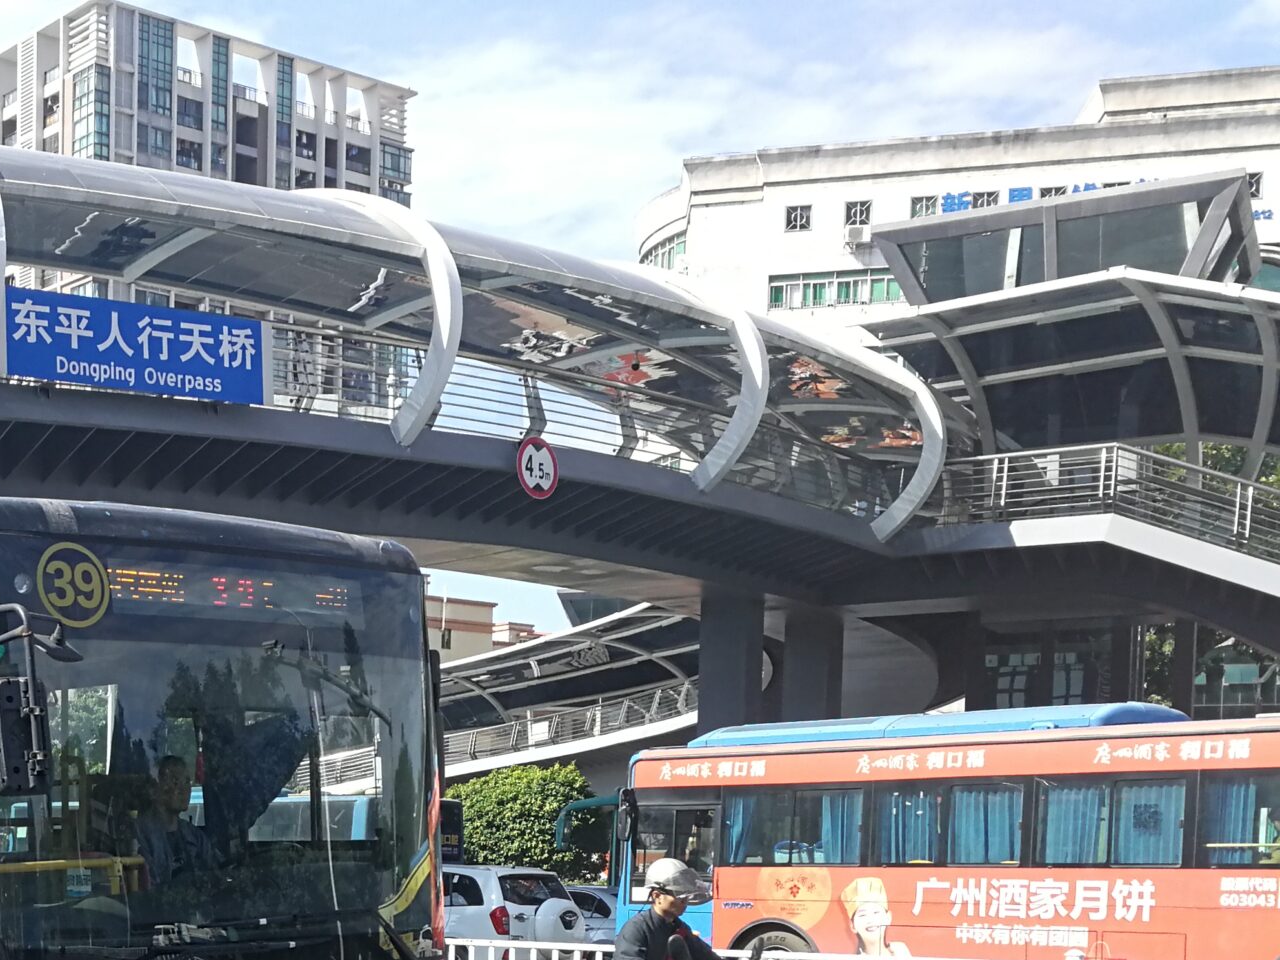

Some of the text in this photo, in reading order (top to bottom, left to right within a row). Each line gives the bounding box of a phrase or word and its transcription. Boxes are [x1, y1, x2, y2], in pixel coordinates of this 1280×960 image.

[11, 299, 256, 370] 东平人行天桥
[56, 356, 222, 393] Dongping Overpass
[524, 454, 551, 481] 4.5m
[45, 559, 101, 609] 39
[911, 877, 1157, 922] 广州酒家月饼
[1219, 893, 1276, 908] 603043
[955, 923, 1089, 948] 中秋有你有团圆
